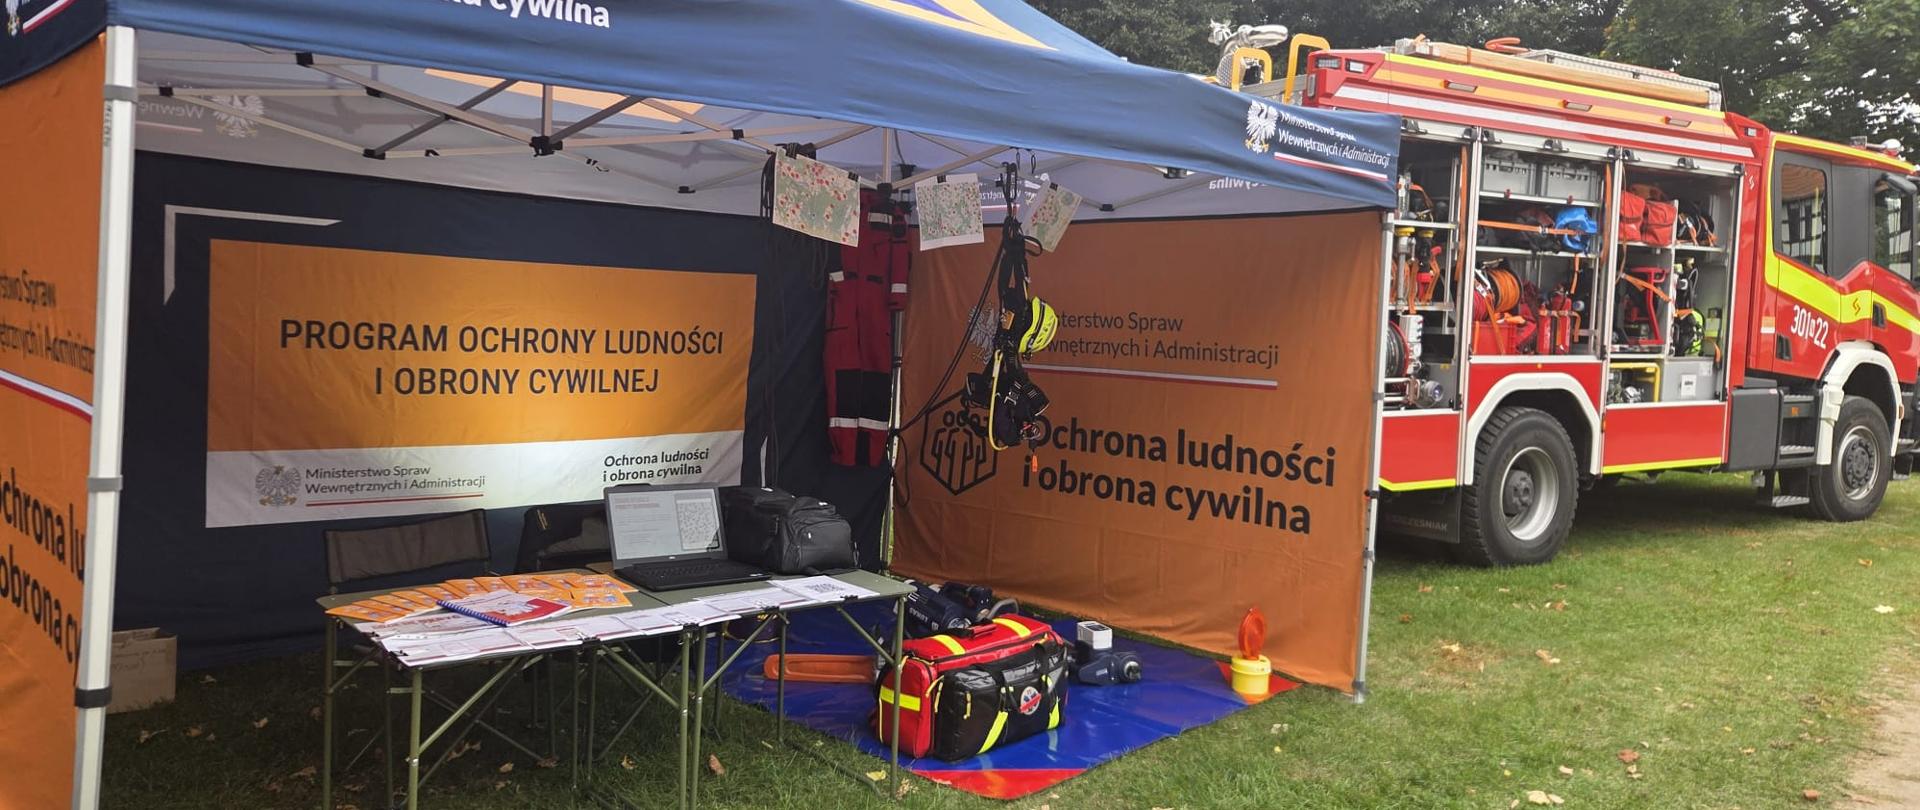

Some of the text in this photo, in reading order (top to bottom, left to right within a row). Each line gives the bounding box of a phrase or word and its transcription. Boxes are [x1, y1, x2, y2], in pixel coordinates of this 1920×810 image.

[1278, 128, 1338, 156] Wewnętrznych
[1342, 145, 1391, 168] Administracji
[1129, 311, 1183, 333] Spraw
[280, 319, 724, 354] PROGRAM OCHRONY LUDNOŚCI
[1152, 341, 1279, 369] Administracji
[375, 367, 659, 395] I OBRONY CYWILNEJ
[604, 448, 709, 467] Ochrona ludności
[1032, 414, 1337, 487] Ochrona ludności
[305, 465, 431, 479] Ministerstwo Spraw
[305, 480, 401, 494] Wewnętrznych
[409, 475, 485, 490] Administracji
[610, 468, 654, 482] obrona
[656, 464, 702, 479] cywilna
[1023, 455, 1311, 535] i obrona cywilna
[0, 466, 66, 565] chrona
